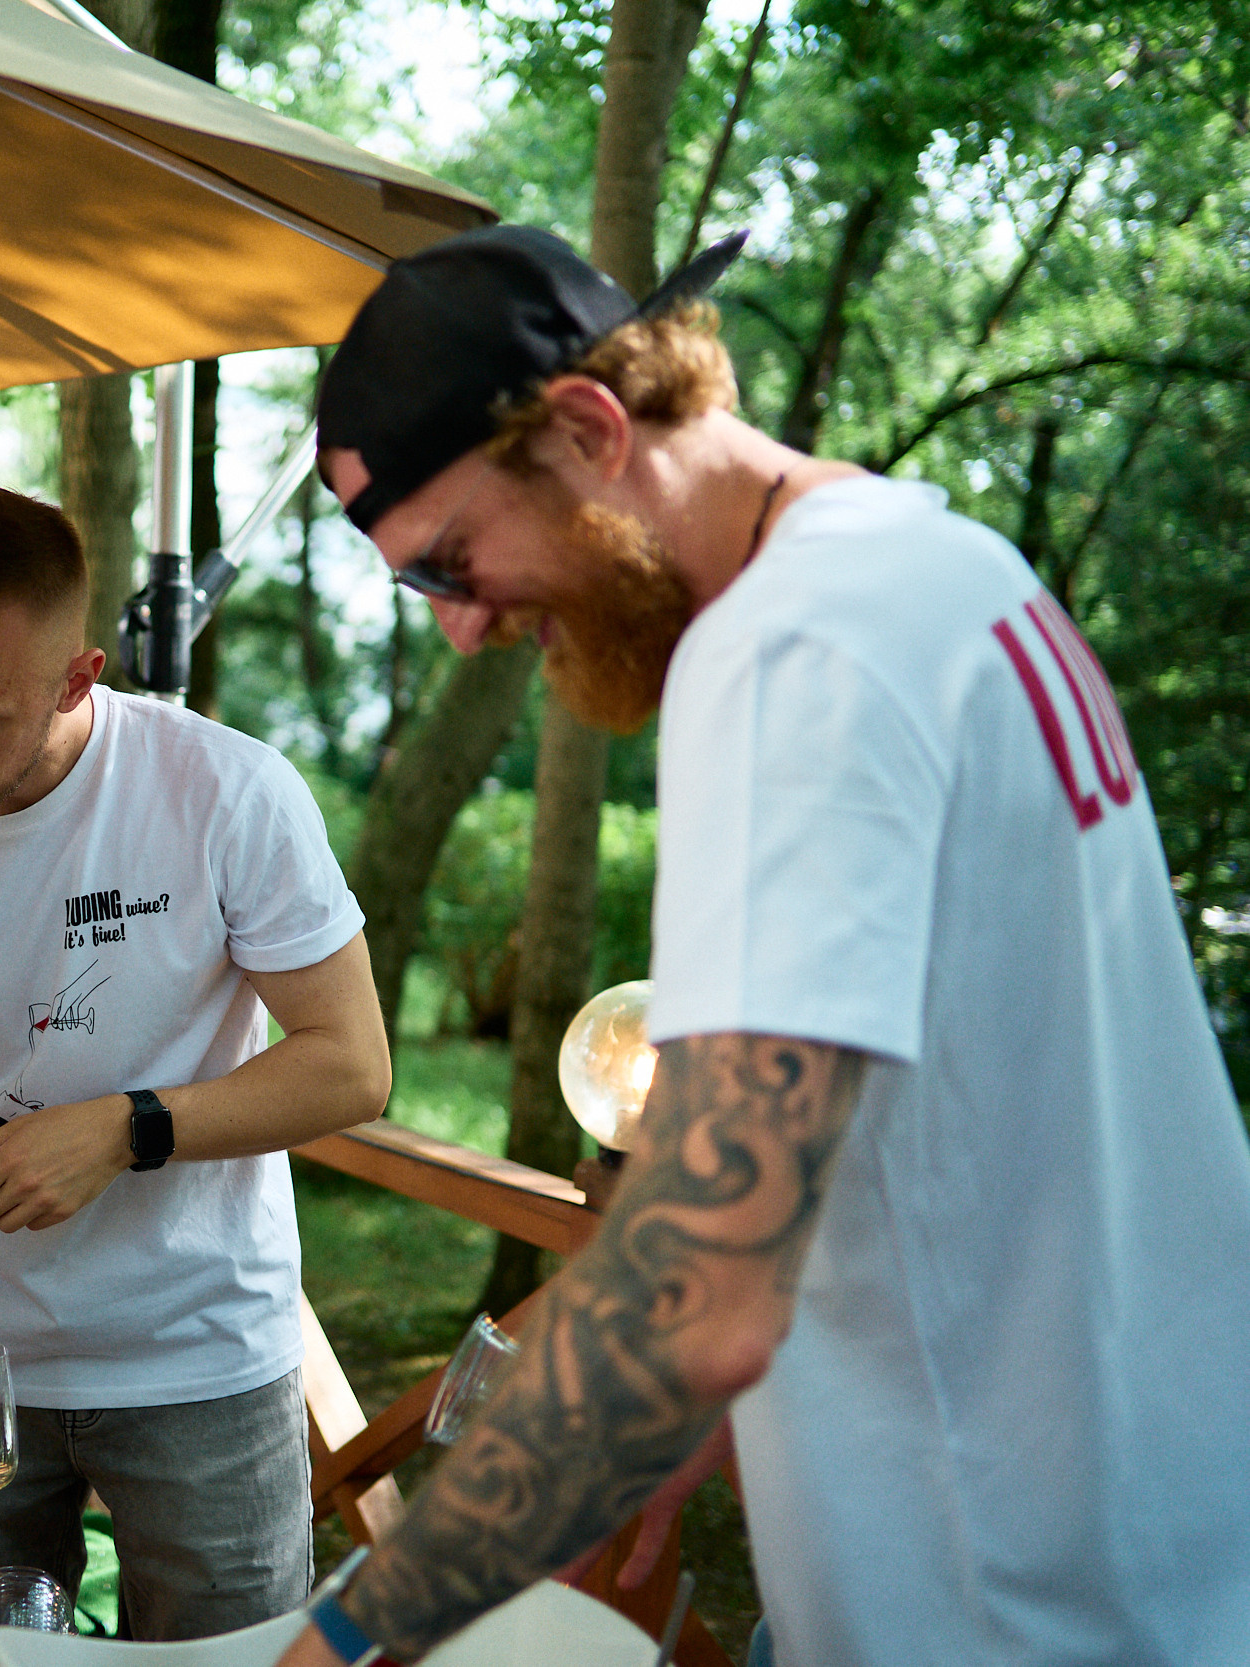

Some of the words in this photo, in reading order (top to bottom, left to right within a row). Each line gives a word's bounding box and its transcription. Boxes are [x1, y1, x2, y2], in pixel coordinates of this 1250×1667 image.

[990, 587, 1139, 832] LU
[65, 889, 123, 927] LUDING
[125, 893, 170, 917] wine?
[64, 930, 85, 950] It's
[92, 922, 126, 947] fine!
